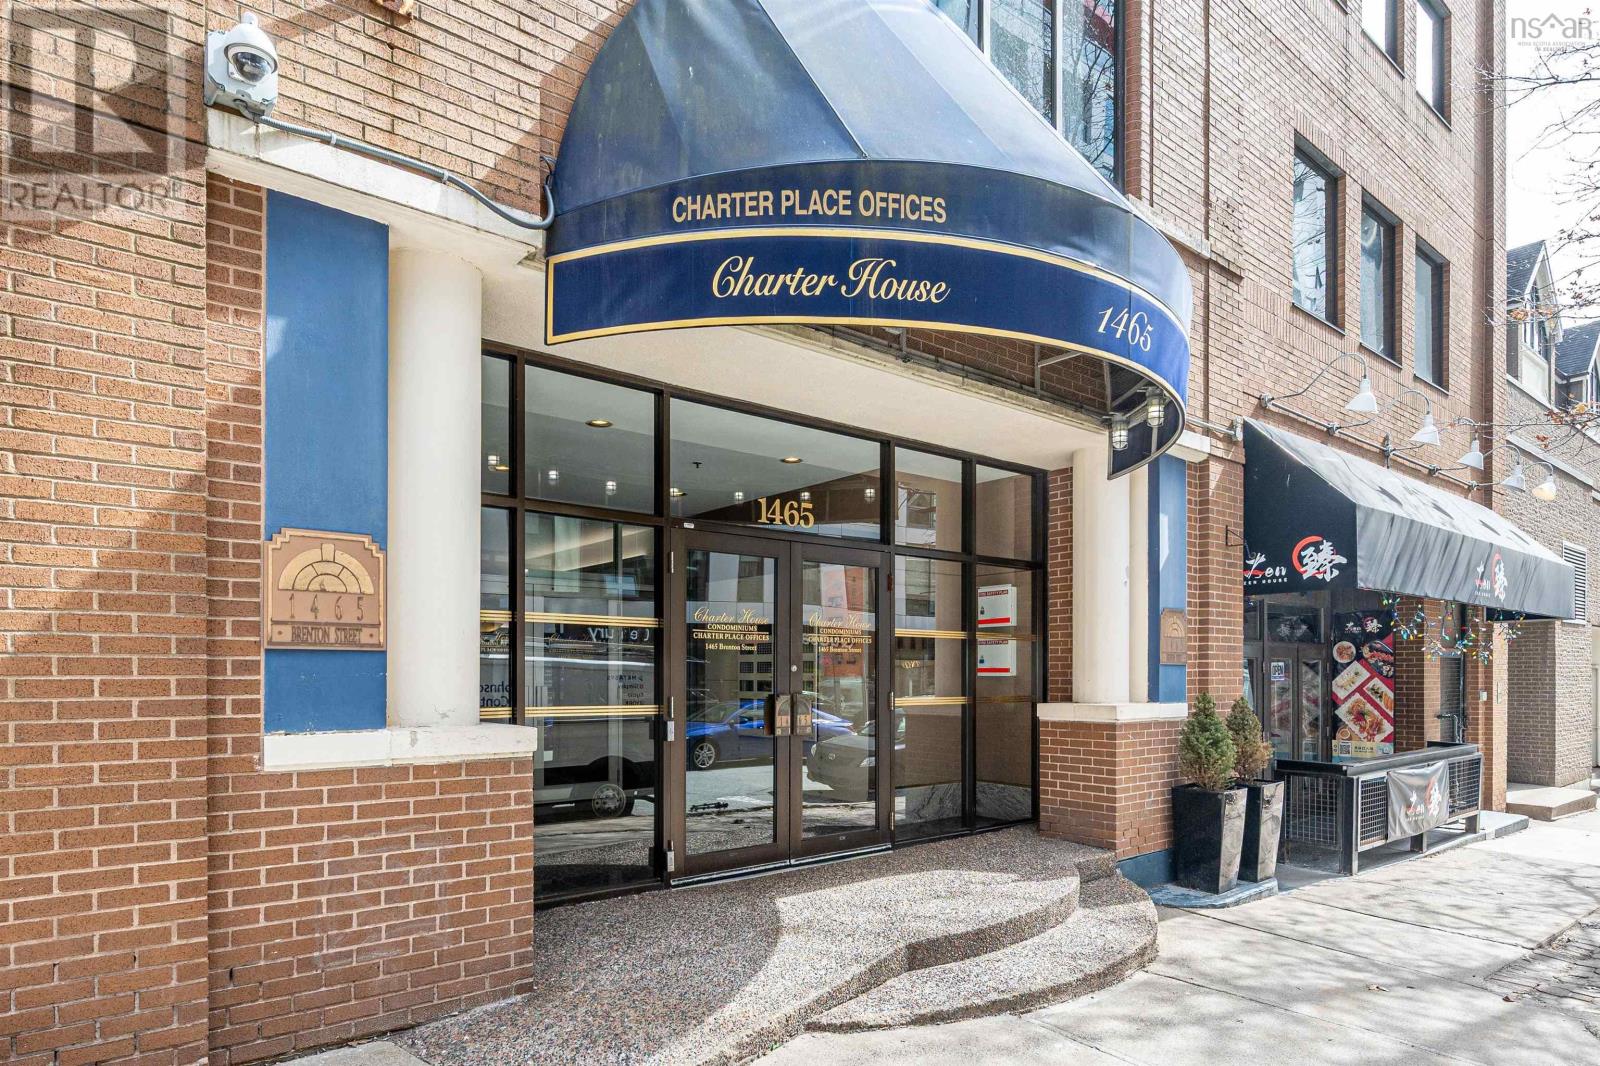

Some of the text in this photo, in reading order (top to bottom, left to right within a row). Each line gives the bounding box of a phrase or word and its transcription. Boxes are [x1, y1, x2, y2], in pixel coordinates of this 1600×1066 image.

[672, 189, 947, 224] CHARTER PLACE OFFICES
[711, 255, 951, 304] Charter House
[1097, 306, 1154, 352] 1465
[757, 497, 815, 529] 1465
[289, 592, 364, 621] 1465
[693, 606, 769, 625] Charter House
[291, 626, 363, 643] BRENTON STREET
[693, 632, 724, 640] CHARTER
[707, 623, 758, 632] CONDOMINIUMS
[719, 643, 740, 651] Brenton
[741, 643, 757, 651] Street
